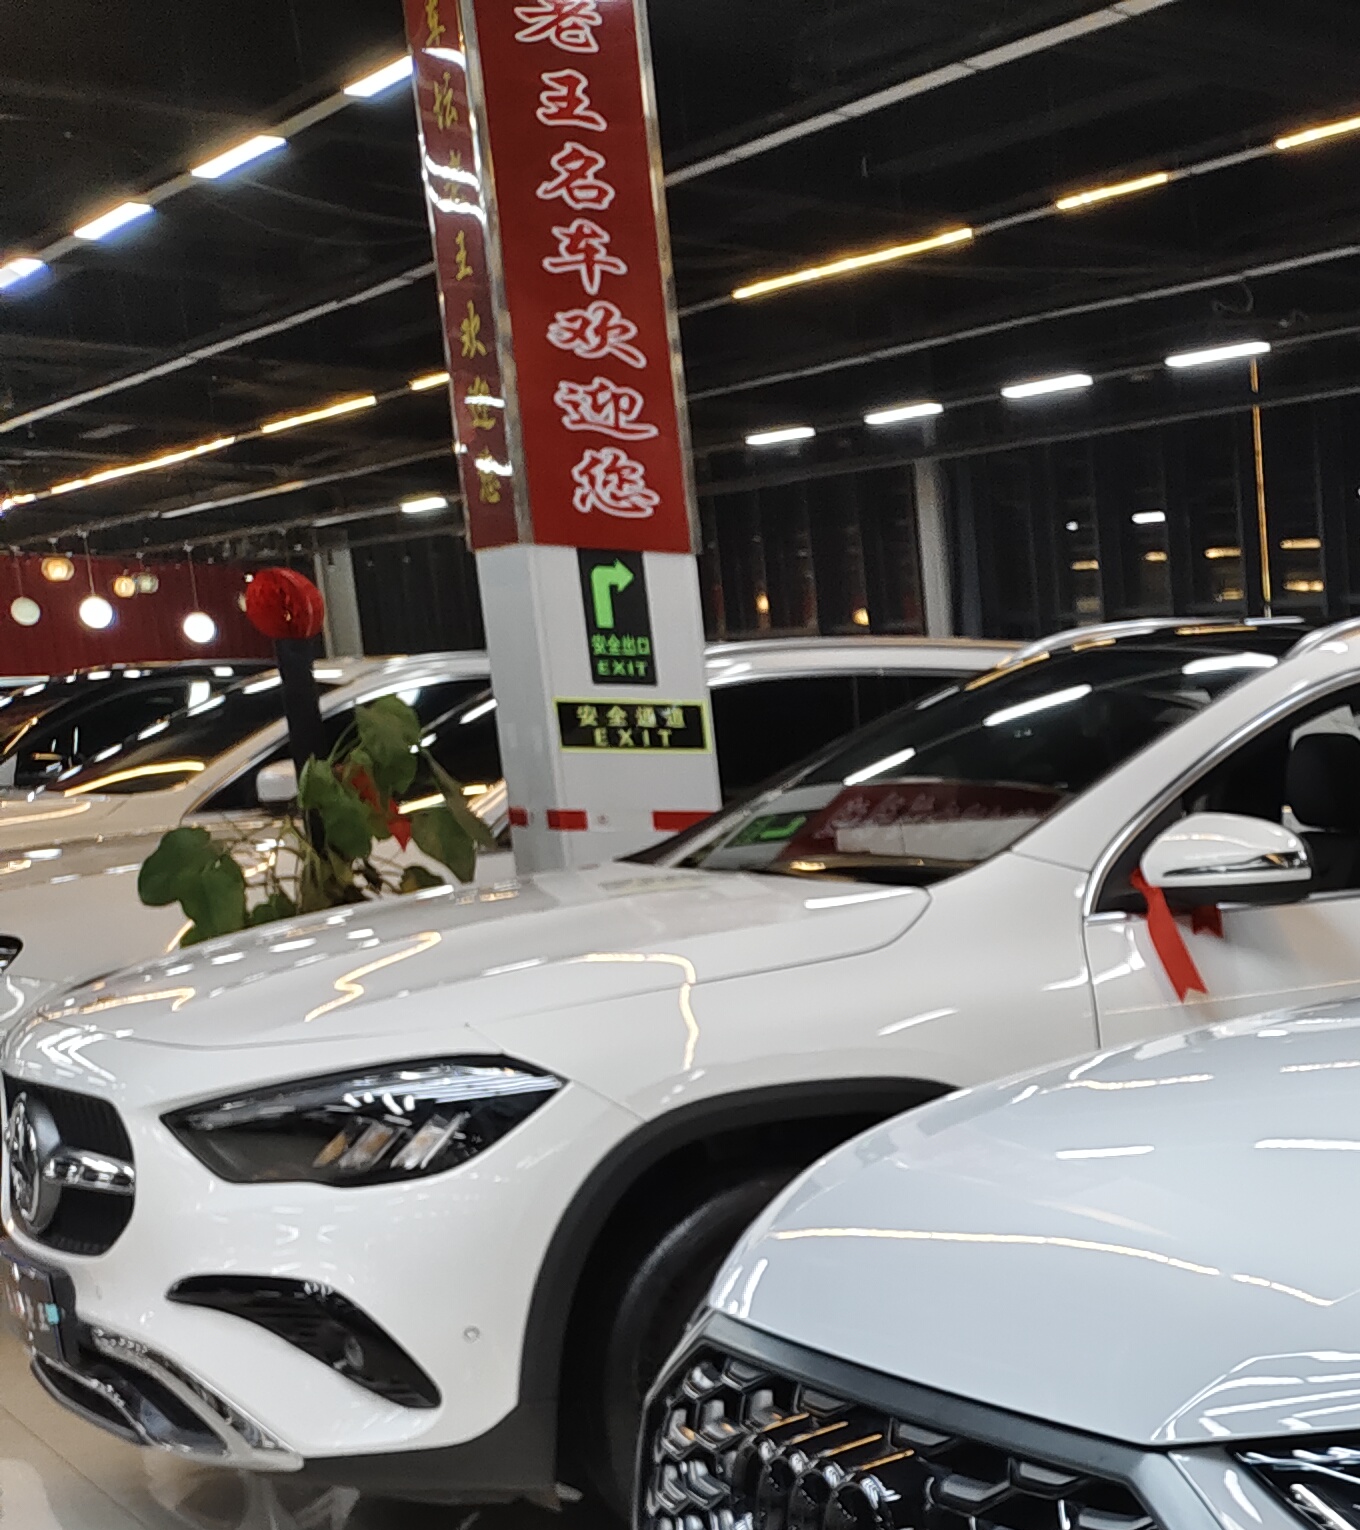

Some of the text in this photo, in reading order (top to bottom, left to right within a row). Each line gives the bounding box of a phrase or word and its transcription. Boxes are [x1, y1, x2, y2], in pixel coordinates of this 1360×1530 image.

[592, 634, 650, 655] 安全出口
[598, 660, 648, 676] EXIT
[595, 729, 672, 747] EXIT
